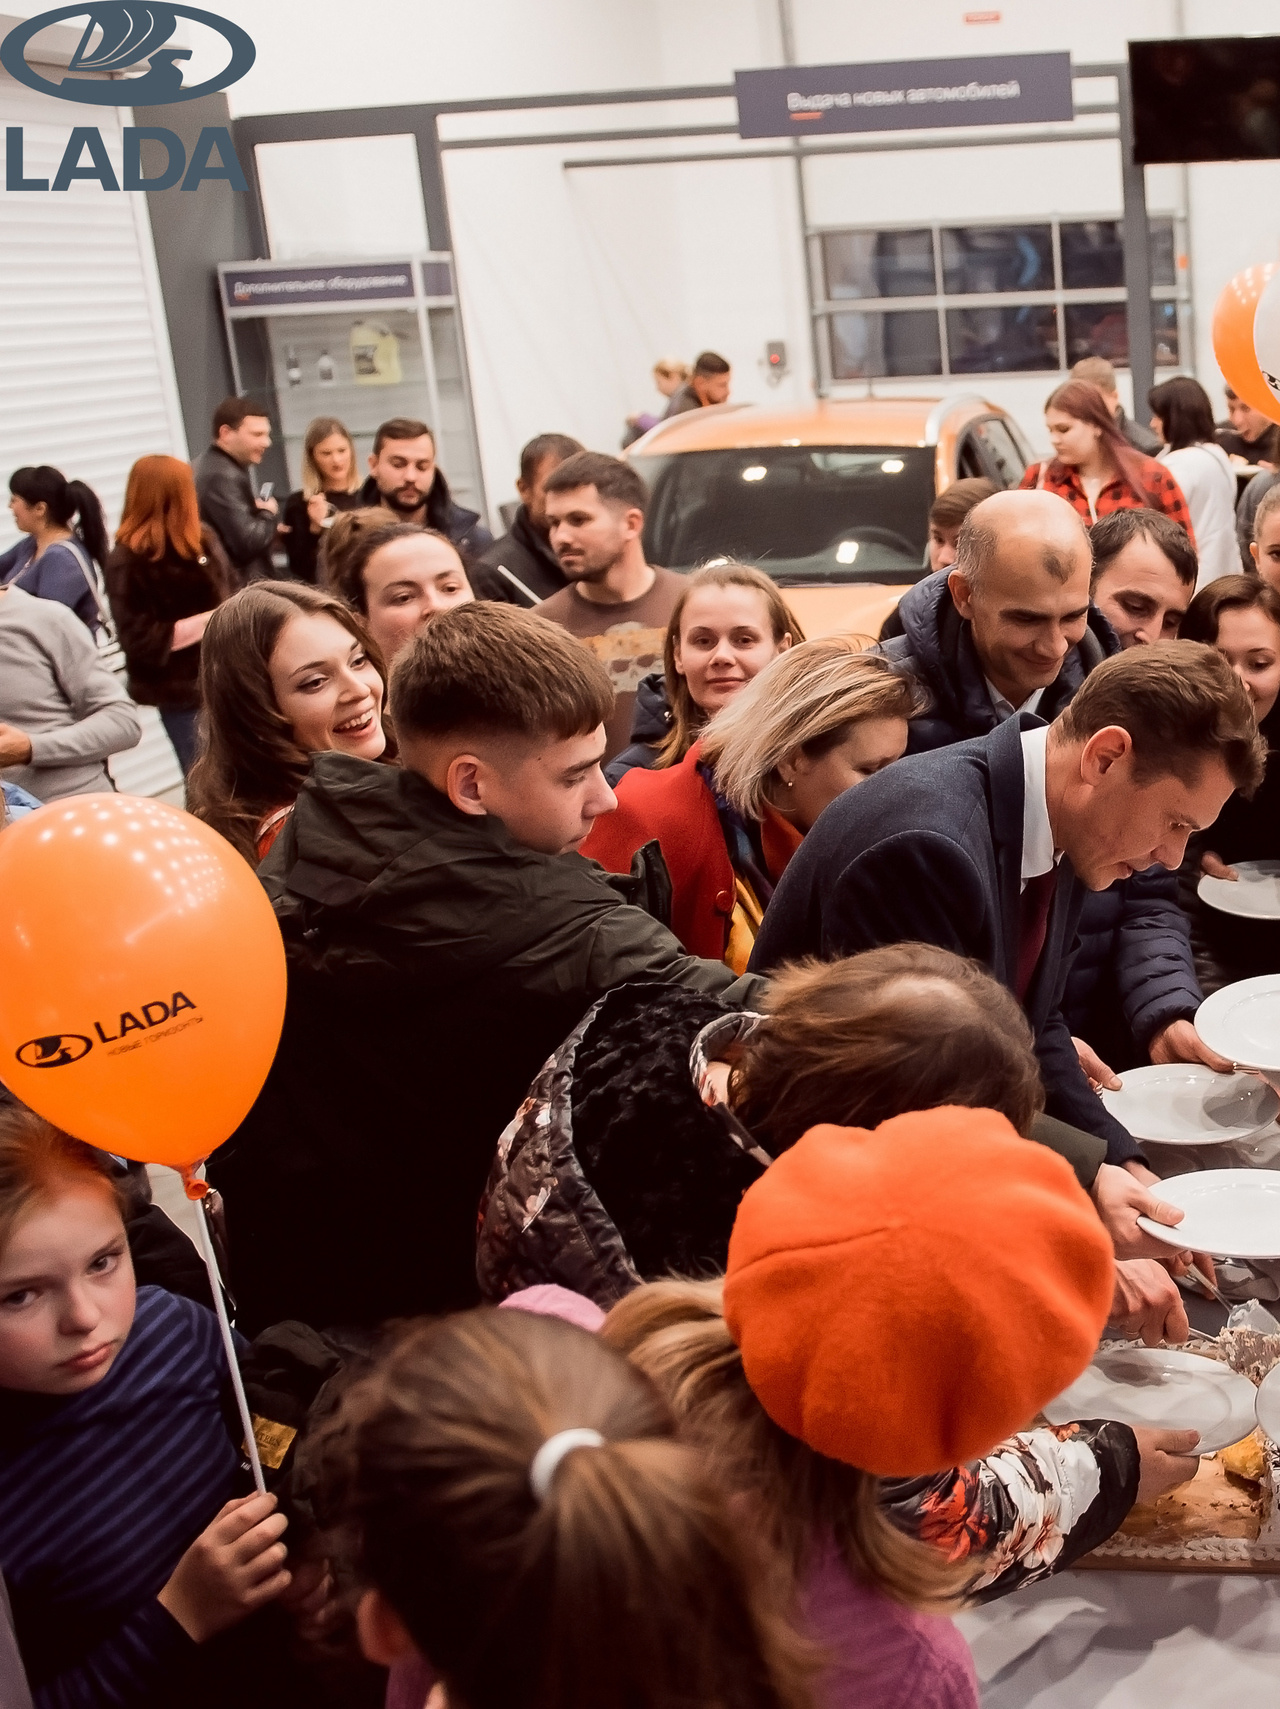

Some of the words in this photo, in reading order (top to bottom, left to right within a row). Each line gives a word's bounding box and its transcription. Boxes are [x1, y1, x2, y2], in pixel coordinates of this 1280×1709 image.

[787, 92, 851, 112] Выдача
[853, 90, 905, 107] новых
[906, 80, 1021, 105] автомобилей
[93, 991, 197, 1044] LADA
